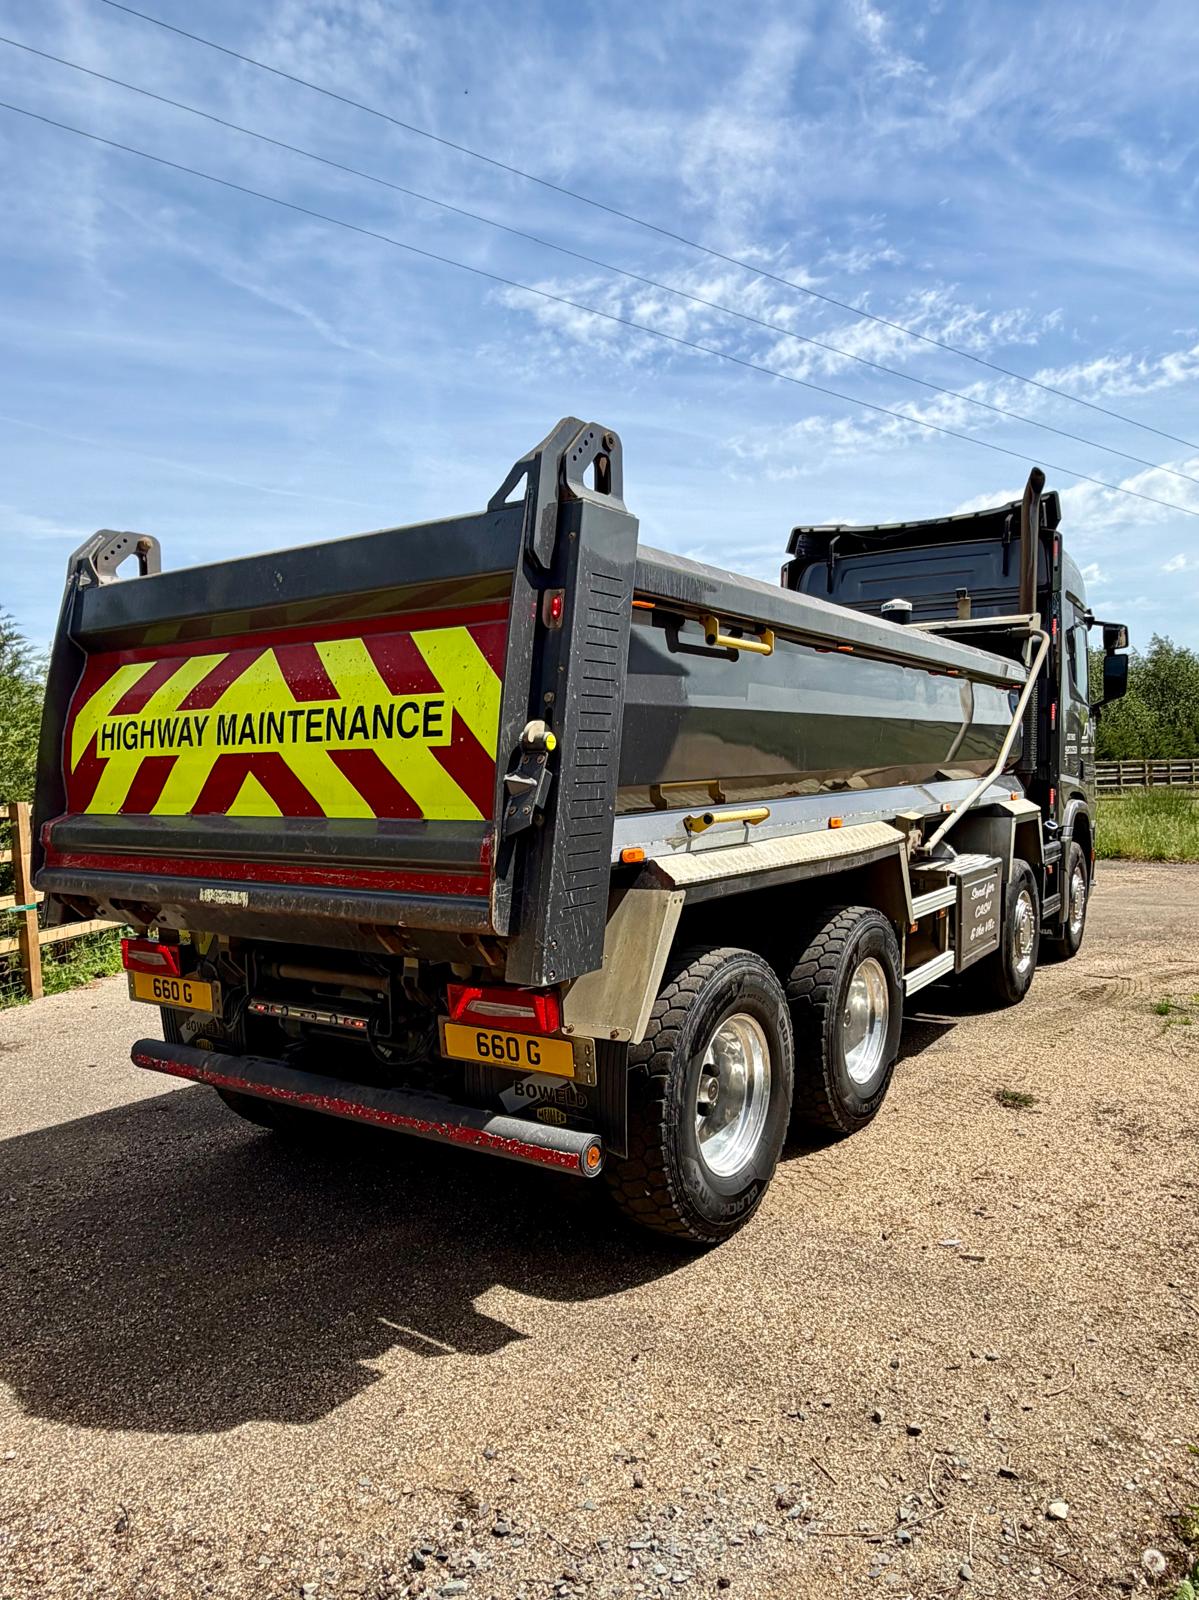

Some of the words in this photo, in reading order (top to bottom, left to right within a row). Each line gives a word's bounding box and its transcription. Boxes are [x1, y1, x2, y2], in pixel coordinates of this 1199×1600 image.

[101, 715, 209, 751] HIGHWAY
[216, 701, 445, 746] MAINTENANCE
[154, 978, 179, 1001] 660
[184, 984, 192, 1003] G
[476, 1032, 520, 1062] 660
[526, 1040, 541, 1065] G
[514, 1081, 587, 1109] BOWELD
